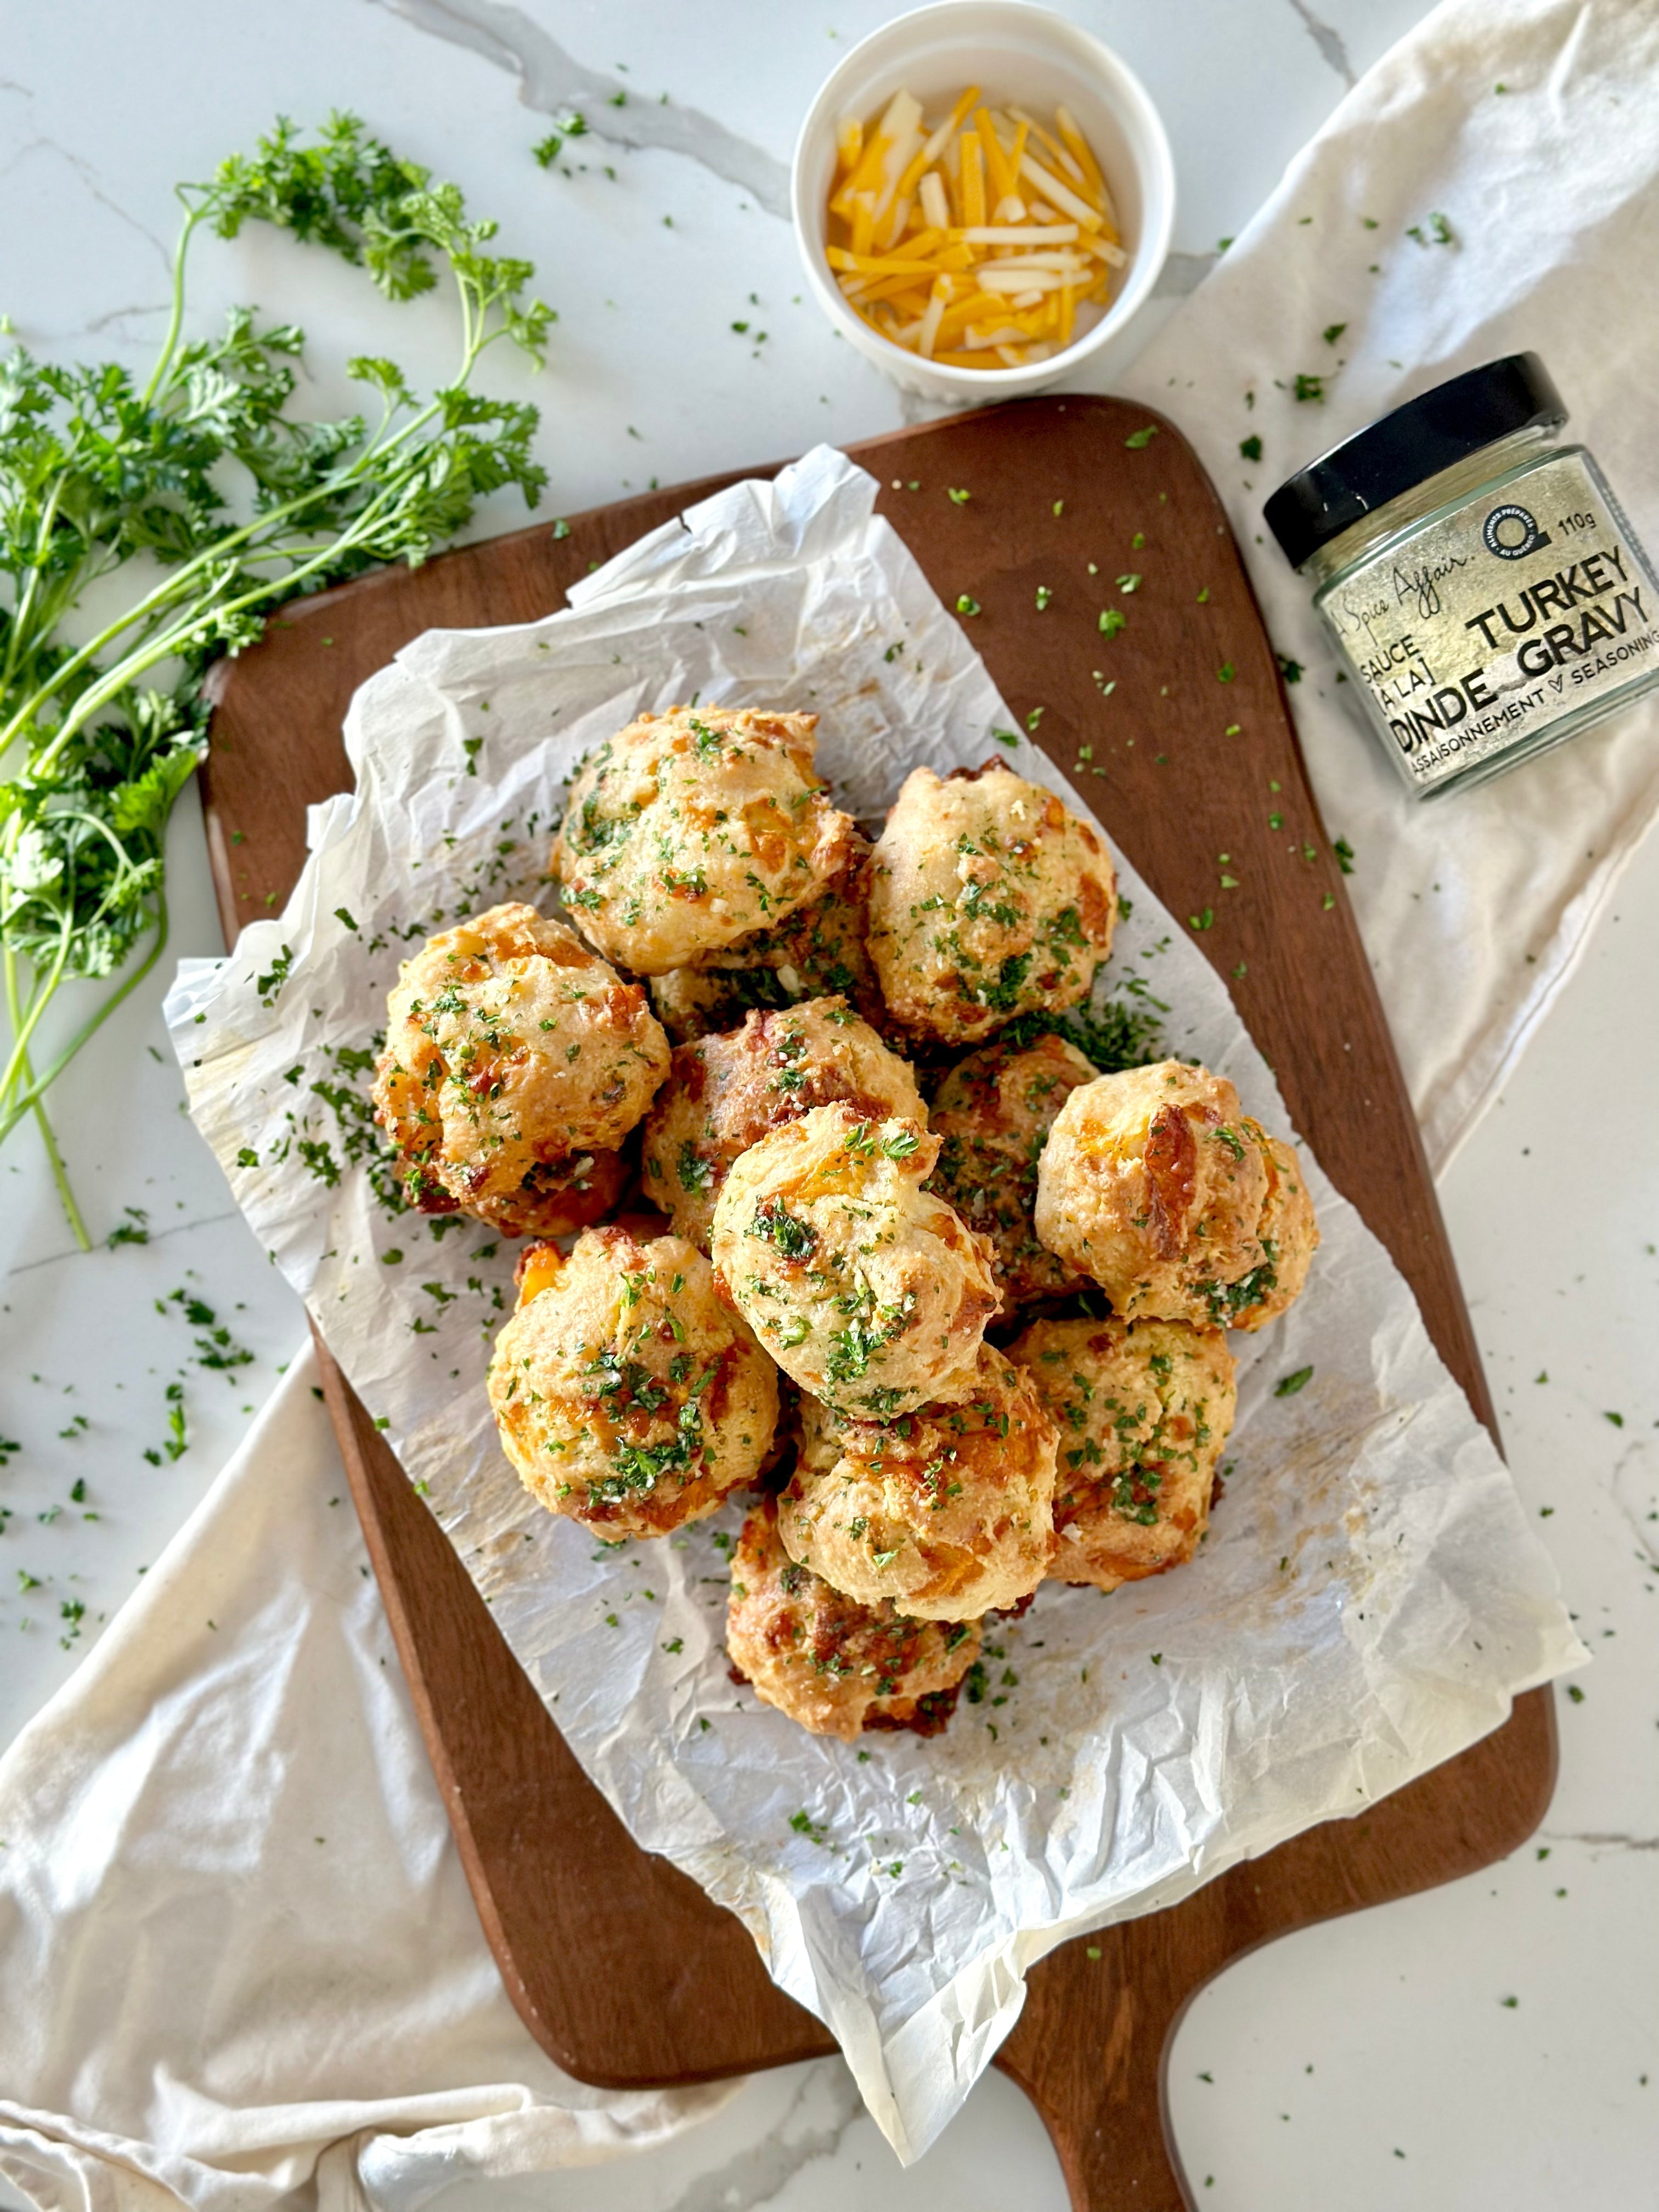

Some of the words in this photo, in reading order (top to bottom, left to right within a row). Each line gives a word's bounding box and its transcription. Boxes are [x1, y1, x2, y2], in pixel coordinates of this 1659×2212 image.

[1558, 512, 1597, 536] 110g
[1342, 595, 1390, 647] Spice
[1464, 544, 1628, 650] TURKEY
[1517, 586, 1649, 678] GRAVY
[1360, 634, 1420, 684] SAUCE
[1410, 688, 1545, 774] ASSAISONNEMENT
[1571, 630, 1659, 685] SEASONING
[1389, 667, 1499, 754] DINDE
